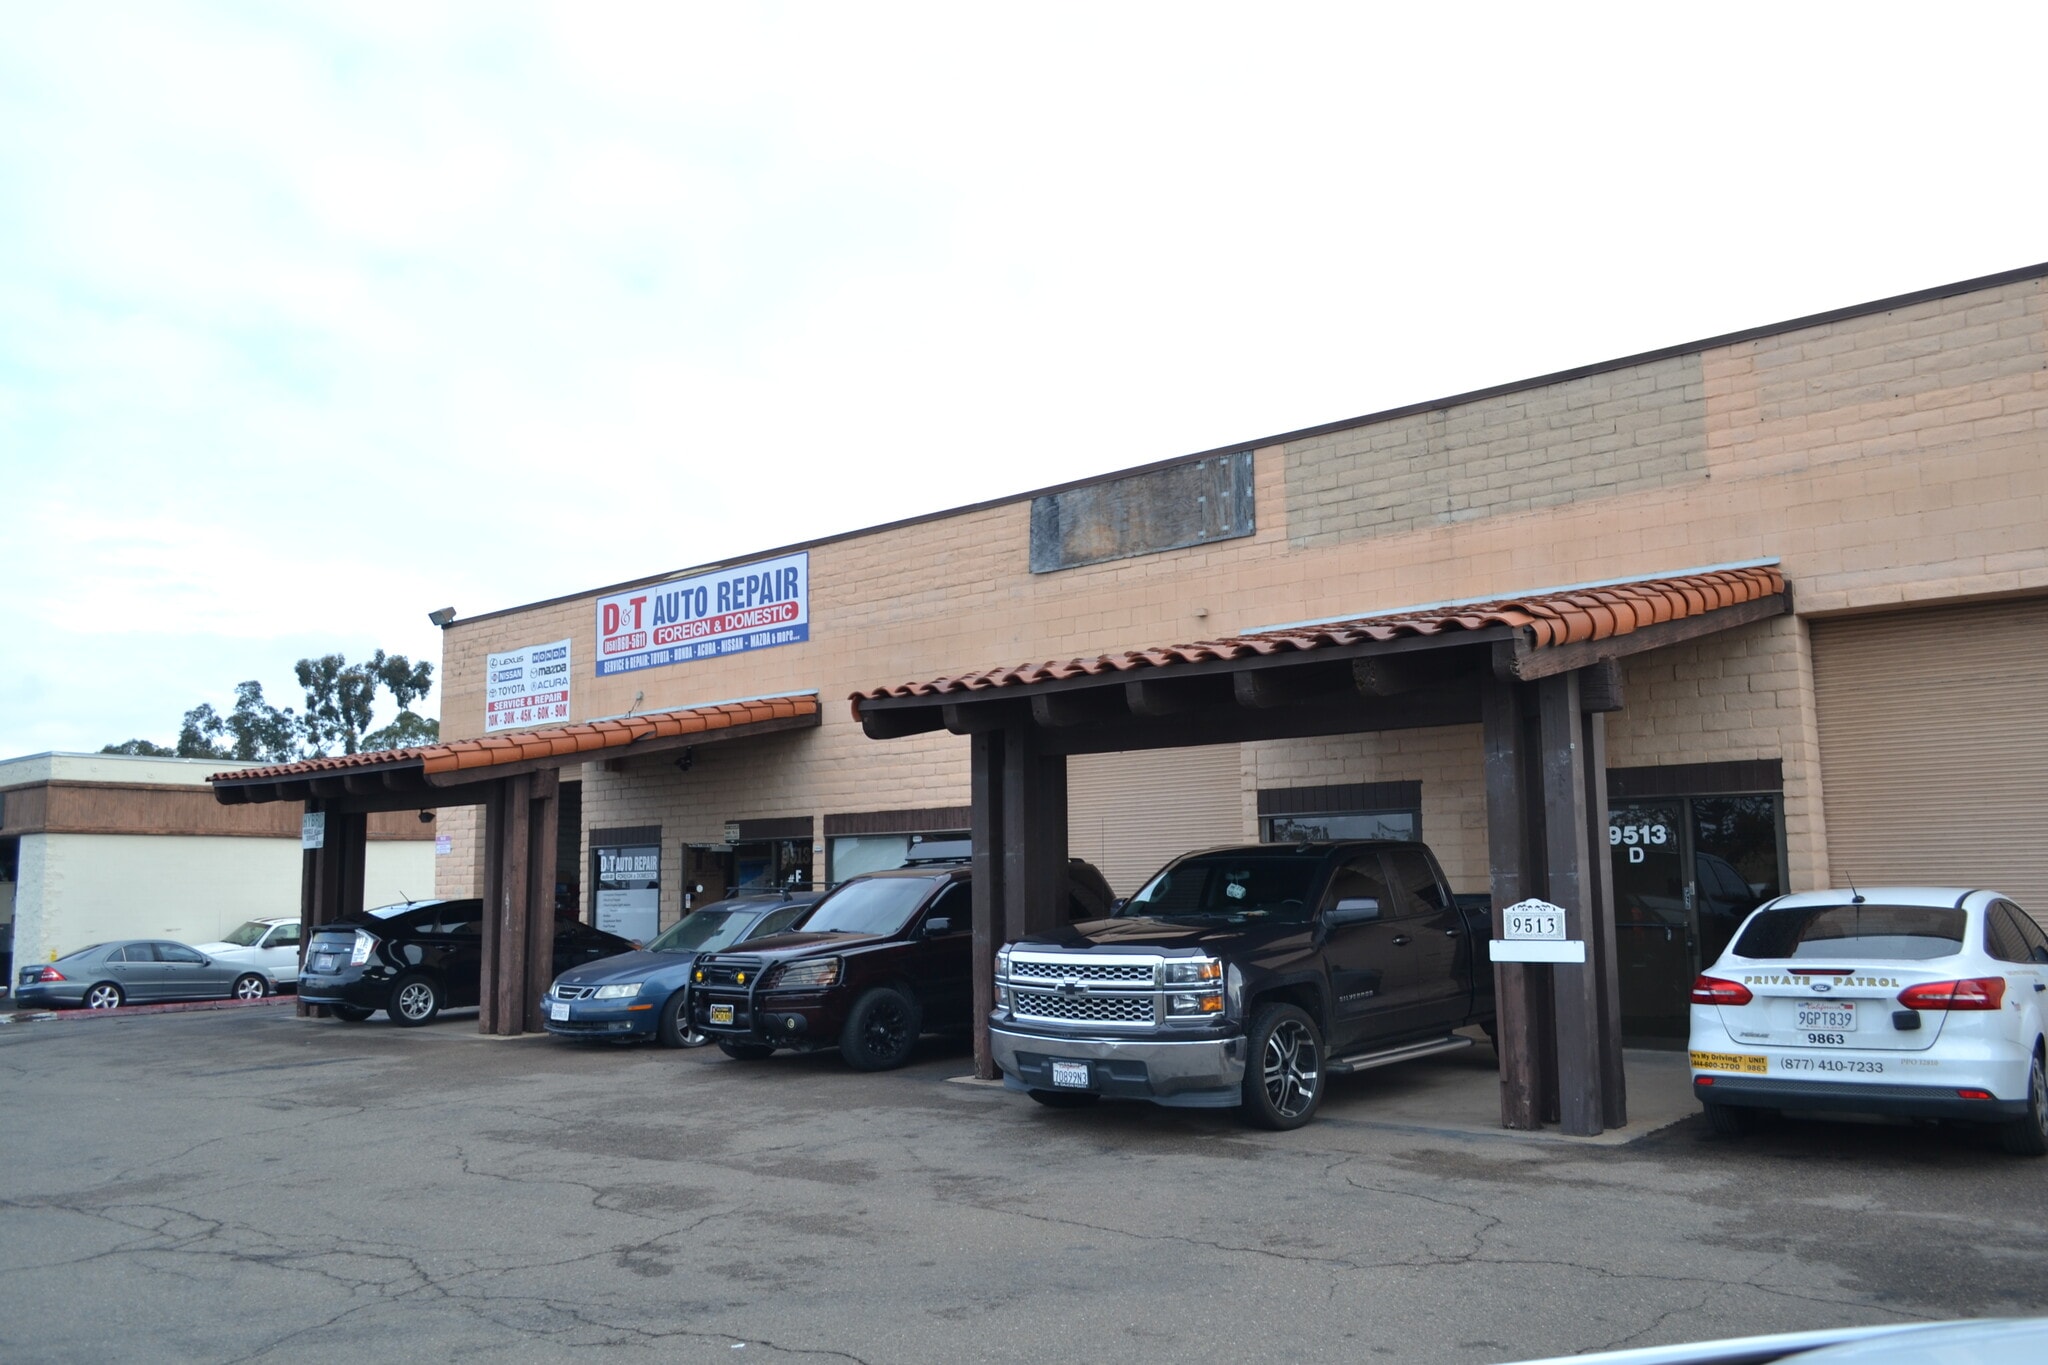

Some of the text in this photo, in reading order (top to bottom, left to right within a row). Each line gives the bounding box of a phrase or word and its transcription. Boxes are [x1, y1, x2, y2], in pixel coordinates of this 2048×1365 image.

[653, 566, 799, 626] AUTO REPAIR
[603, 595, 647, 636] D&T
[658, 604, 792, 643] FOREIGN & DOMESTIC
[533, 647, 566, 663] HONDA
[604, 657, 624, 673] SERVICE
[650, 650, 669, 665] TOYOTA
[674, 646, 692, 661] HONDA
[697, 642, 716, 656] ACURA
[721, 637, 743, 653] NISSAN
[750, 632, 771, 647] MAZDA
[500, 656, 524, 665] LEXUS
[500, 668, 522, 681] NISSAN
[498, 684, 525, 696] TOYOTA
[537, 677, 568, 690] ACURA
[494, 692, 562, 710] SERVICE & REPAIR
[1609, 825, 1667, 845] 9513
[1629, 847, 1644, 863] D
[616, 856, 633, 872] AUTO
[634, 856, 657, 871] REPAIR
[1513, 917, 1556, 934] 9513
[1744, 975, 1900, 988] PRIVATE PATROL
[1799, 1011, 1852, 1026] 9GPT839
[1808, 1033, 1845, 1045] 9863
[1711, 1054, 1742, 1063] Driving?
[1780, 1058, 1884, 1073] (877) 410-7233
[1747, 1064, 1766, 1072] 9863
